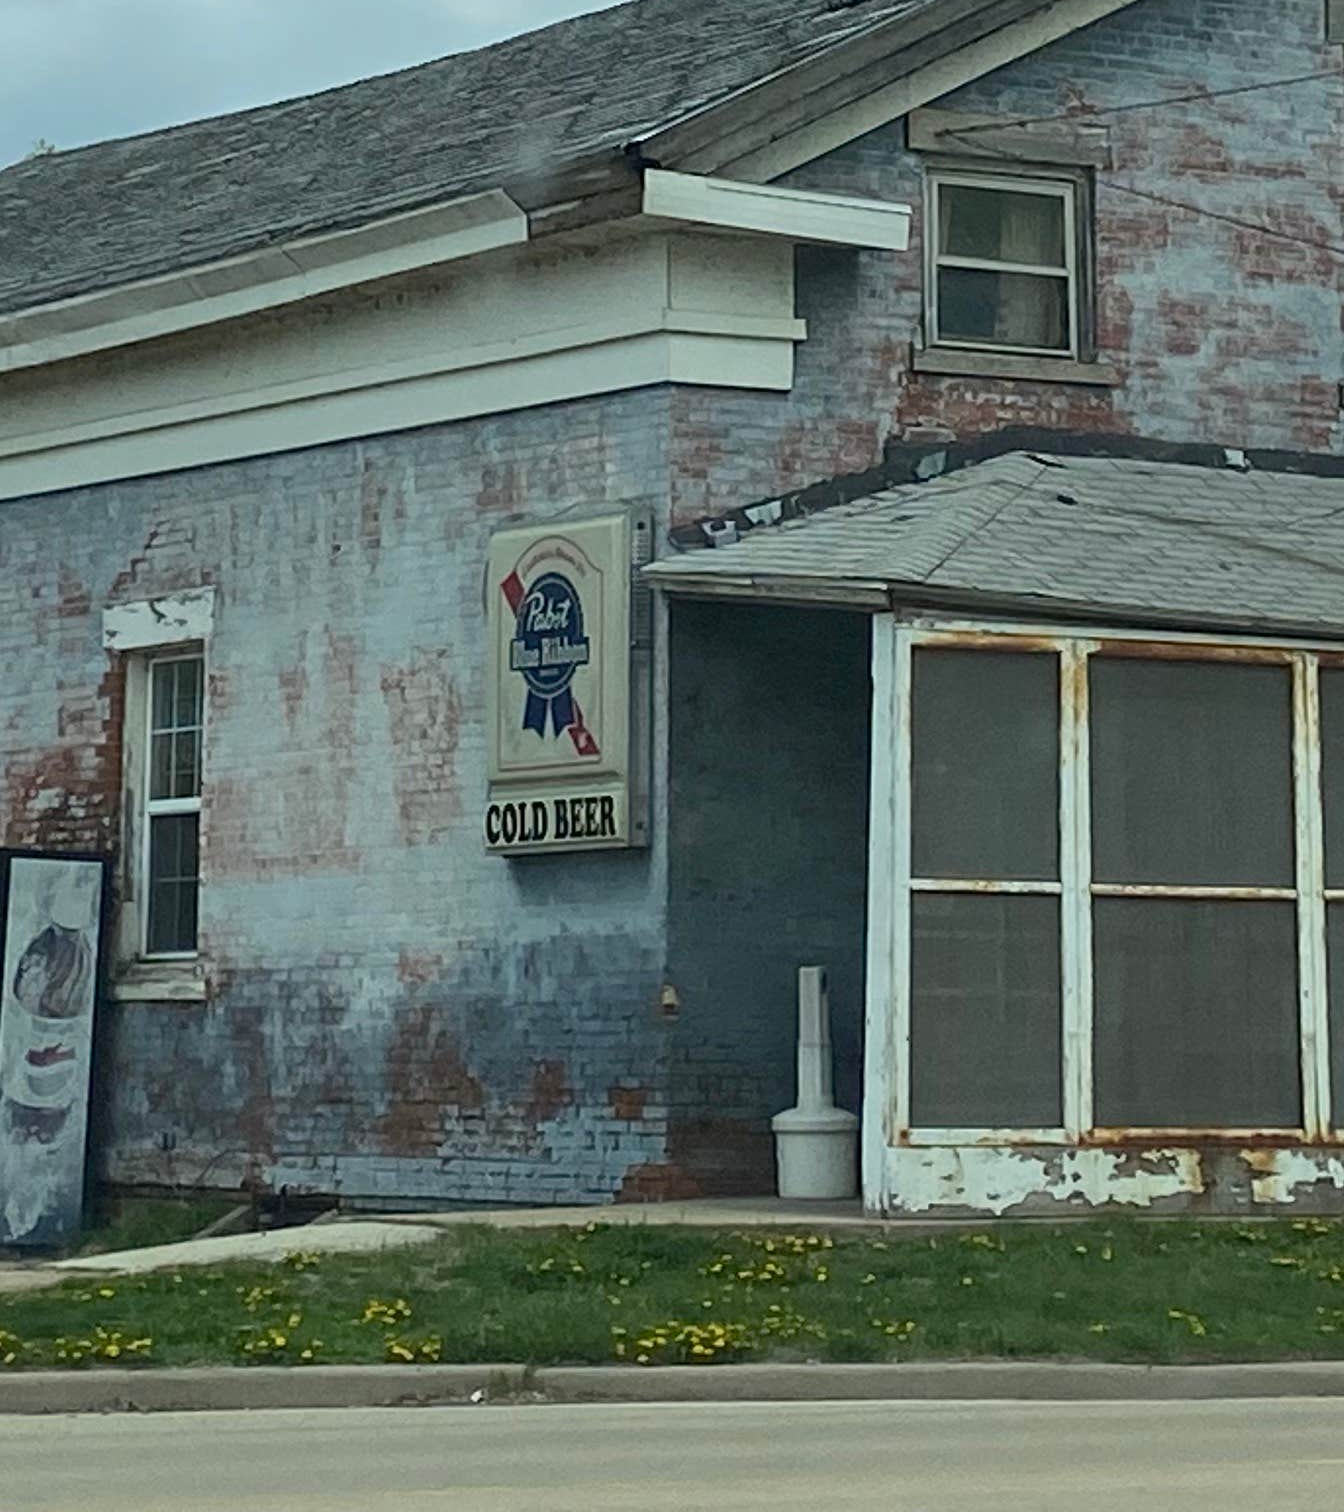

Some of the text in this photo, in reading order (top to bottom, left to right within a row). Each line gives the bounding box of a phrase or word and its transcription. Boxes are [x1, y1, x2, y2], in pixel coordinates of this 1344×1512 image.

[525, 591, 571, 632] Pabst
[486, 795, 616, 844] COLD BEER
